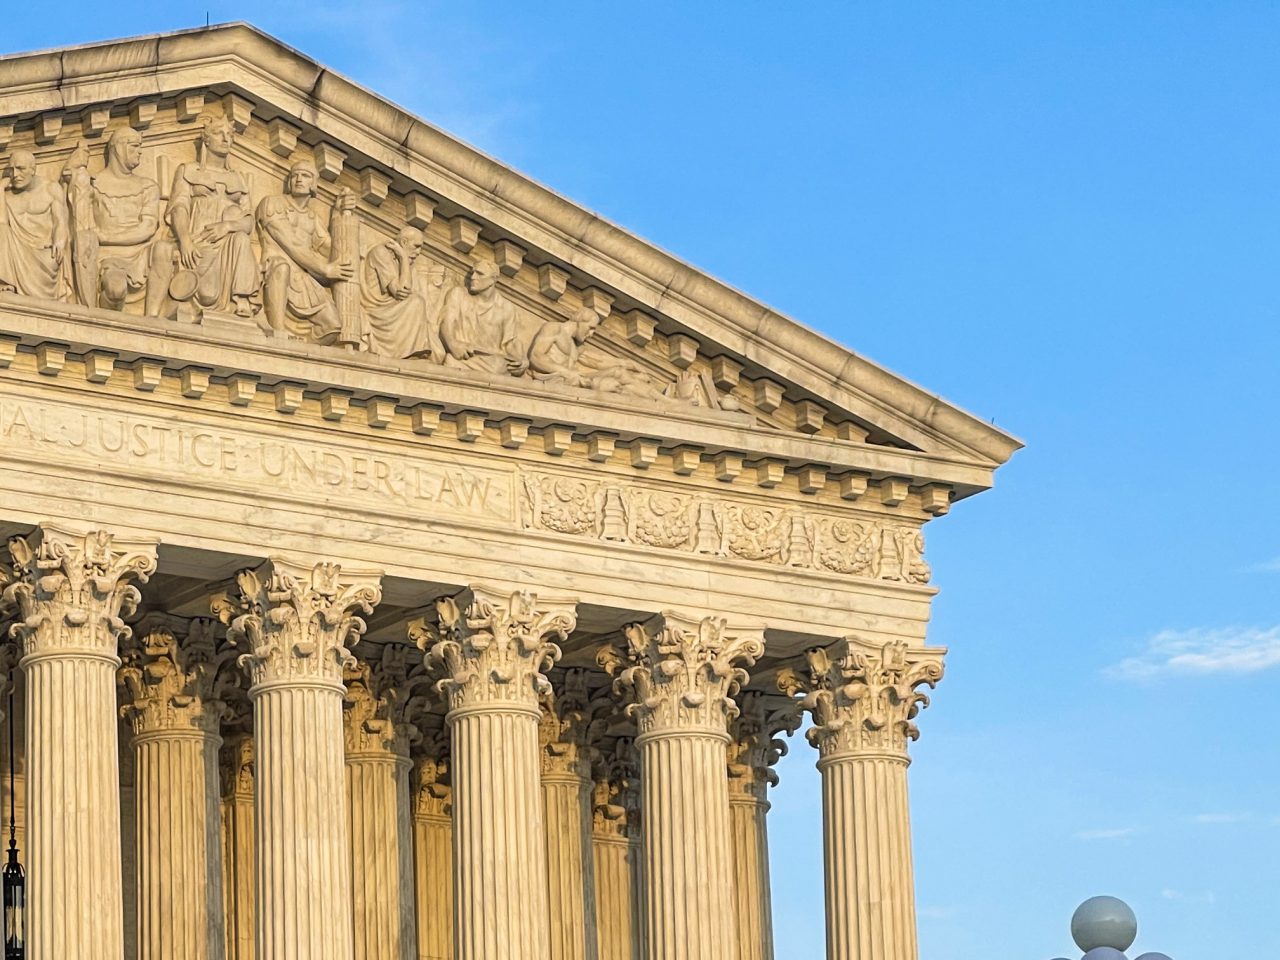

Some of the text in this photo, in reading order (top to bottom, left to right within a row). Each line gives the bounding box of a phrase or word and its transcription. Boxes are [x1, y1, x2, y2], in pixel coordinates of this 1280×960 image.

[68, 414, 238, 471] JUSTICE
[259, 441, 401, 497] UNDER
[413, 466, 492, 508] LAW
